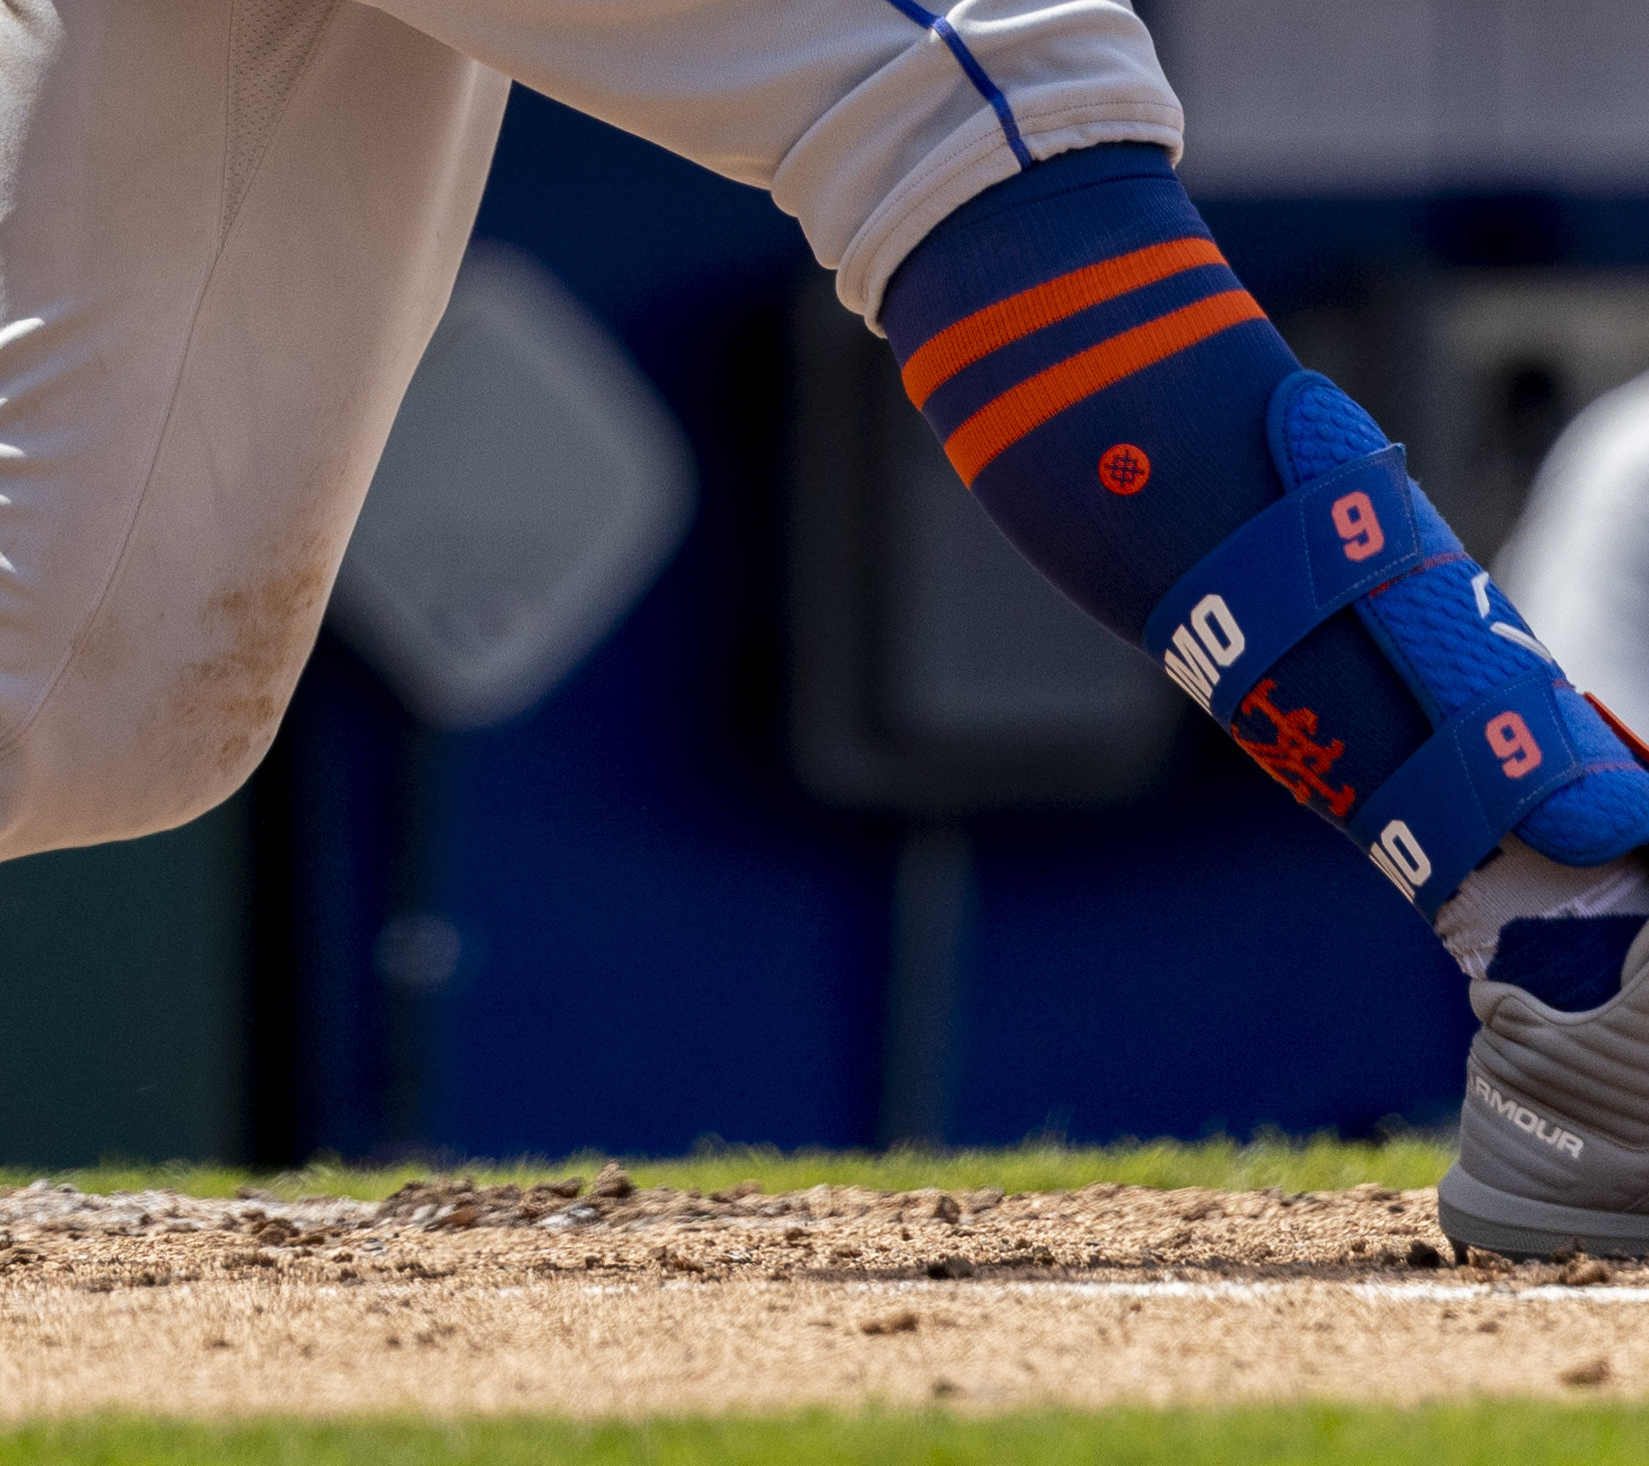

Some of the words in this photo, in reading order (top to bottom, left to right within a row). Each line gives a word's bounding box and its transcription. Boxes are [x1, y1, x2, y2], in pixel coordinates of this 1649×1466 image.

[1331, 490, 1385, 562] 9
[1484, 710, 1542, 780] 9
[1468, 1071, 1585, 1160] RMOUR
